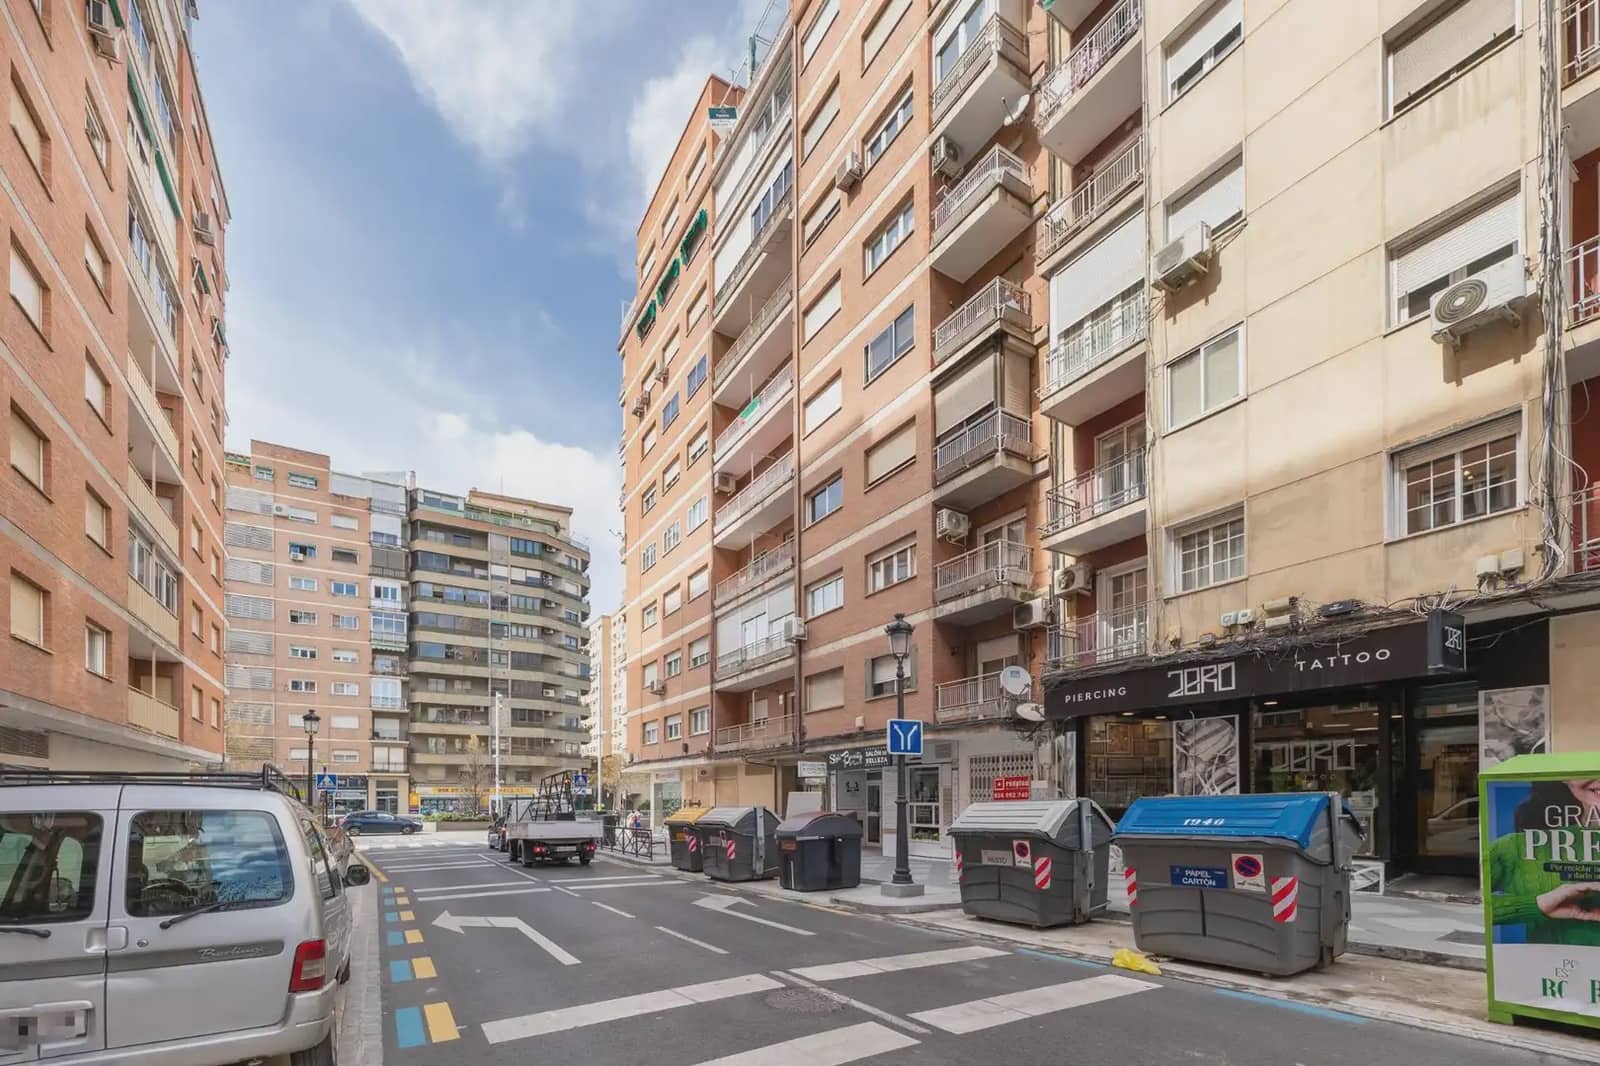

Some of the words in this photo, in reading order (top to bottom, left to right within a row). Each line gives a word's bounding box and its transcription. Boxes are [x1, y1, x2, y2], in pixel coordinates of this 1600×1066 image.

[1297, 648, 1391, 672] TATTOO
[1167, 661, 1236, 698] ZERO
[1064, 687, 1128, 703] PIERCING
[1182, 876, 1216, 887] CARTÓN
[1184, 869, 1212, 878] PAPEL
